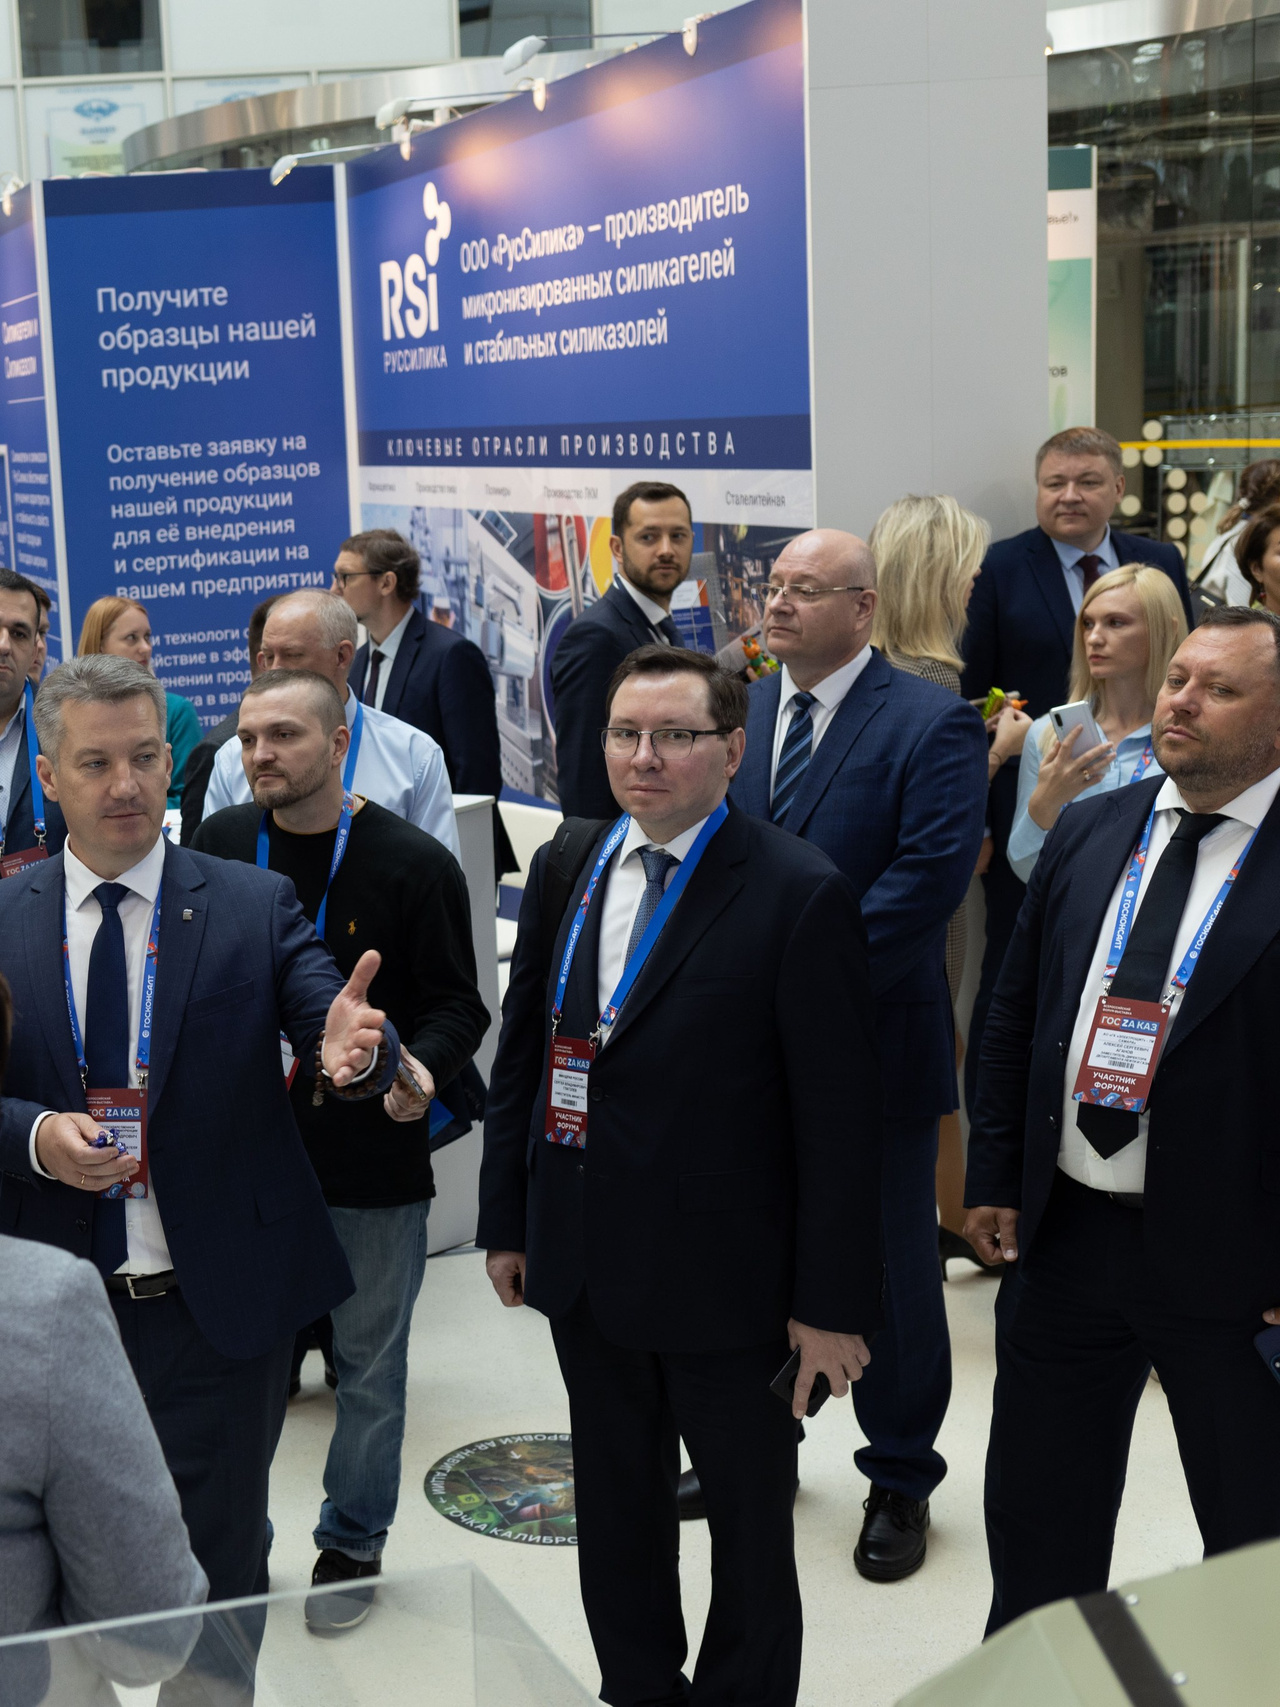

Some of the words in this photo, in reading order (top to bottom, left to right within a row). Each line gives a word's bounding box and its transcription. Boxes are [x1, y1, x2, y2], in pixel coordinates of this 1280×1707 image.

[459, 239, 489, 273] ООО
[491, 222, 584, 271] «РусСилика»
[604, 183, 750, 248] производитель
[380, 229, 441, 341] RSi
[461, 269, 613, 323] микронизированных
[615, 237, 735, 296] силикагелей
[96, 285, 228, 317] Получите
[98, 323, 220, 355] образцы
[228, 312, 316, 342] нашей
[463, 344, 473, 365] и
[475, 329, 558, 365] стабильных
[559, 308, 668, 356] силиказолей
[383, 344, 448, 374] РУССИЛИКА
[101, 360, 250, 393] продукции
[107, 443, 202, 463] Оставьте
[207, 437, 277, 457] заявку
[282, 435, 307, 450] на
[387, 437, 463, 457] КЛЮЧЕВЫЕ
[472, 436, 548, 457] ОТРАСЛИ
[561, 431, 735, 460] ПРОИЗВОДСТВА
[109, 469, 219, 493] получение
[223, 461, 321, 486] образцов
[111, 497, 177, 518] нашей
[183, 491, 293, 516] продукции
[725, 491, 786, 507] Сталелитейная
[113, 530, 150, 550] для
[156, 524, 179, 543] её
[185, 518, 295, 541] внедрения
[114, 558, 127, 573] и
[132, 547, 279, 575] сертификации
[286, 544, 310, 560] на
[116, 582, 186, 600] вашем
[191, 570, 325, 598] предприятии
[164, 628, 239, 646] технологи
[152, 652, 206, 667] ействие
[210, 651, 220, 663] в
[162, 673, 213, 688] енении
[217, 669, 251, 685] прод
[602, 816, 631, 858] ГОСКОНСАЛТ
[1114, 899, 1131, 950] ГОСКОНСАЛТ
[1194, 900, 1224, 951] ГОСКОНСАЛТ
[562, 923, 580, 975] ГОСКОНСАЛТ
[143, 974, 155, 1028] ГОСКОНСАЛТ
[1093, 1072, 1136, 1085] УЧАСТНИК
[1094, 1081, 1130, 1094] ФОРУМА
[555, 1112, 582, 1123] УЧАСТНИК
[557, 1122, 580, 1132] ФОРУМА
[500, 1433, 572, 1445] БРОВКИ
[444, 1504, 488, 1532] ТОЧКА
[489, 1528, 579, 1545] КАЛИБРО
